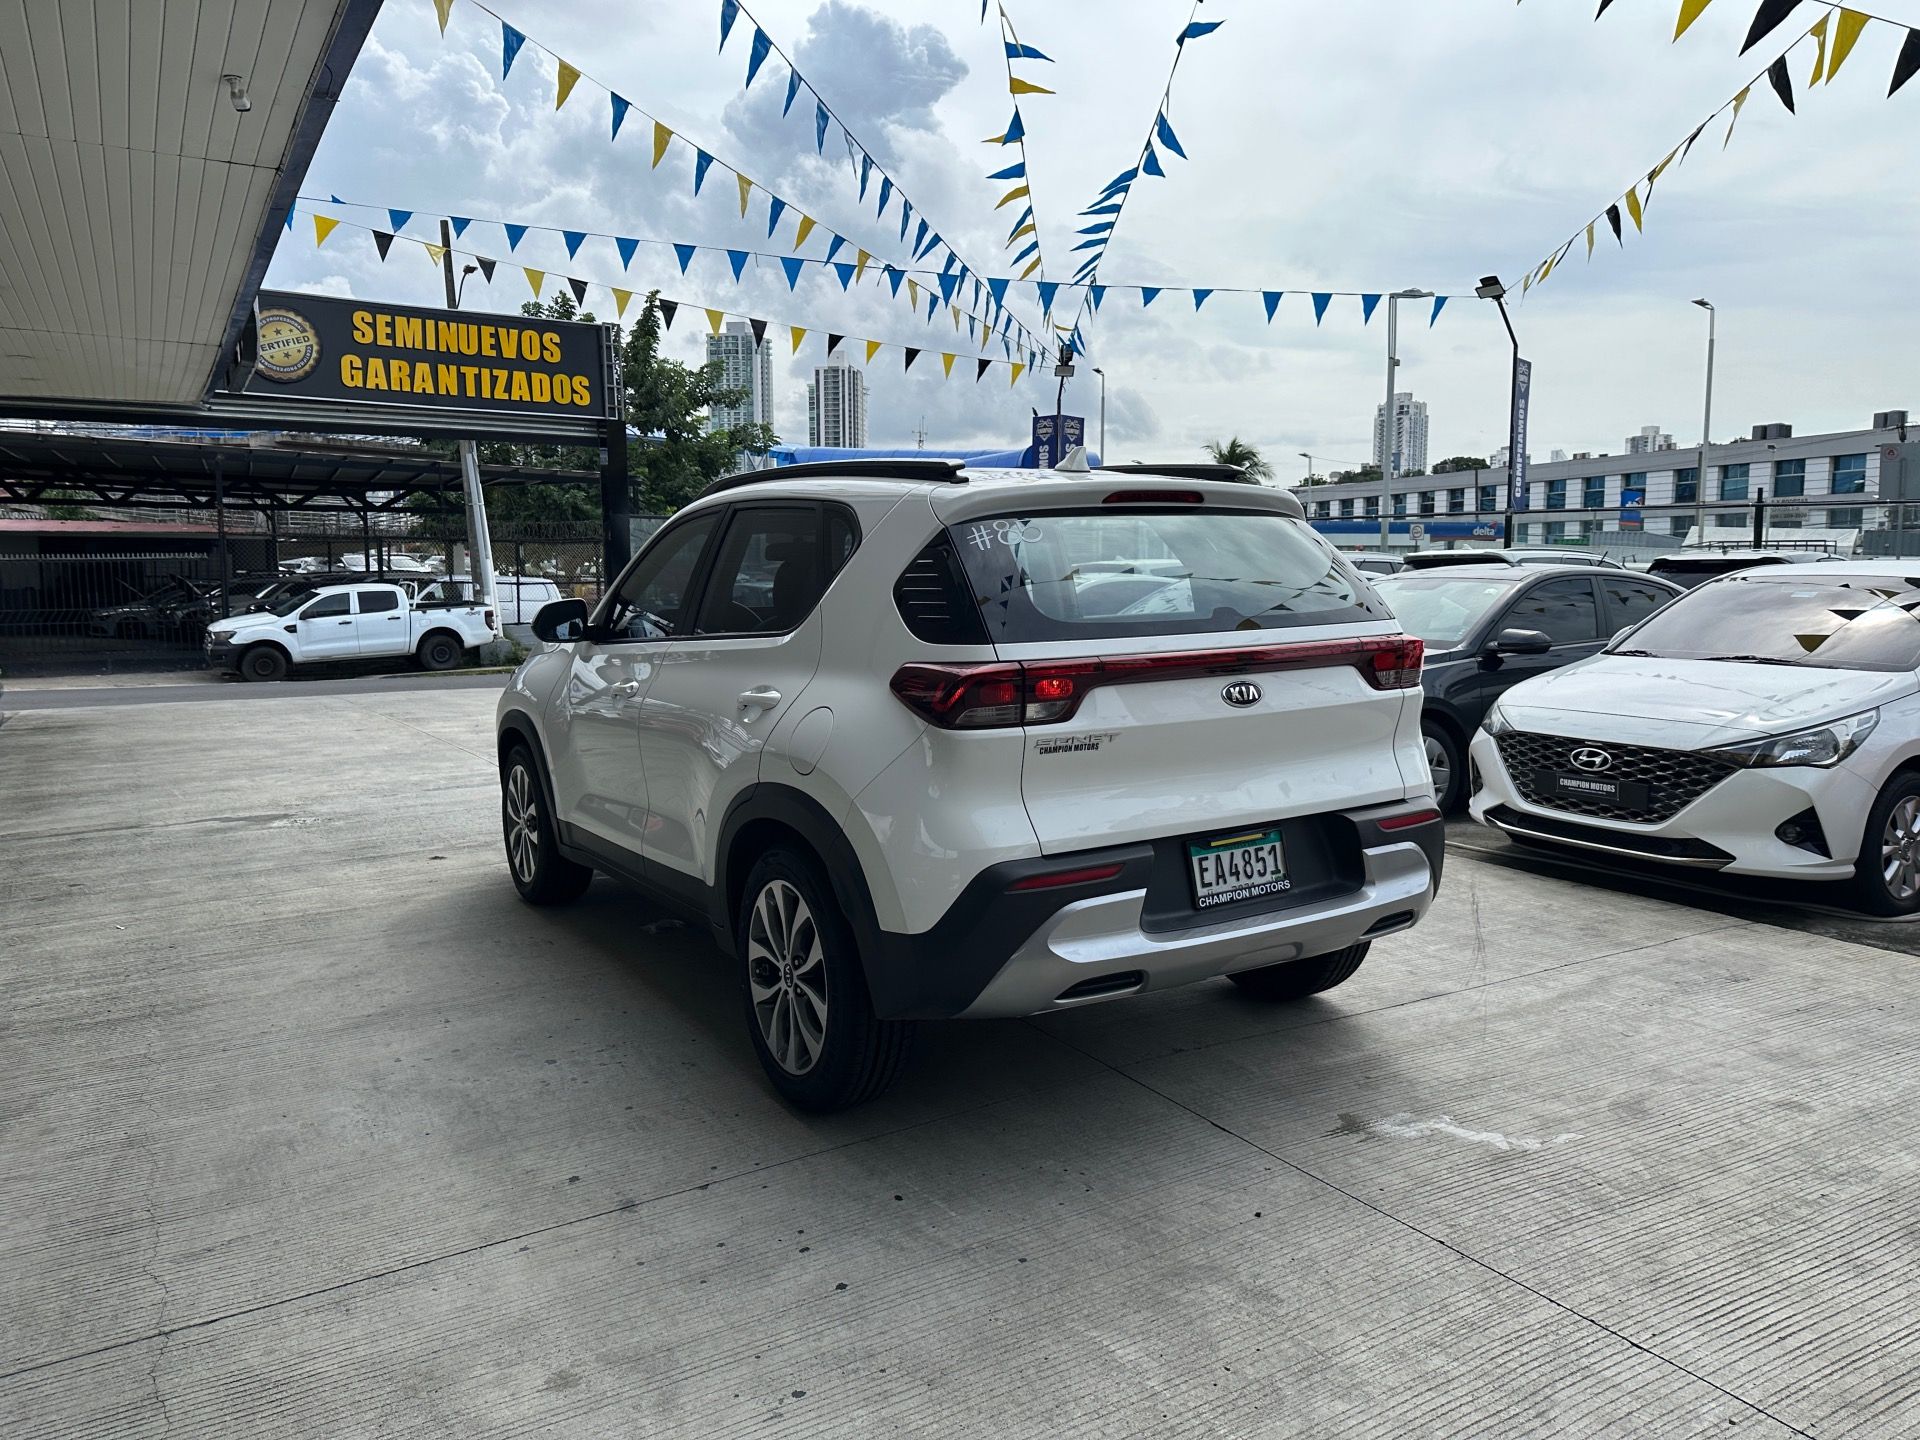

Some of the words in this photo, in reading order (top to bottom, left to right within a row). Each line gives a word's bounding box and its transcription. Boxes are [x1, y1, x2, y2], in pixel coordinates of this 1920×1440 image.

[260, 335, 310, 352] ERTIFIED
[352, 310, 562, 363] SEMINUEVOS
[340, 354, 591, 406] GARANTIZADOS
[1038, 444, 1049, 469] MOS
[1515, 398, 1525, 498] COMPRAMOS
[1472, 526, 1496, 536] delta
[1230, 685, 1259, 702] KIA
[1040, 744, 1073, 755] CHAMPION
[1074, 742, 1100, 752] MOTORS
[1560, 778, 1590, 789] CHAMPION
[1590, 782, 1616, 793] MOTORS
[1198, 844, 1282, 889] EA4851
[1199, 887, 1252, 907] CHAMPION
[1252, 879, 1291, 897] MOTORS
